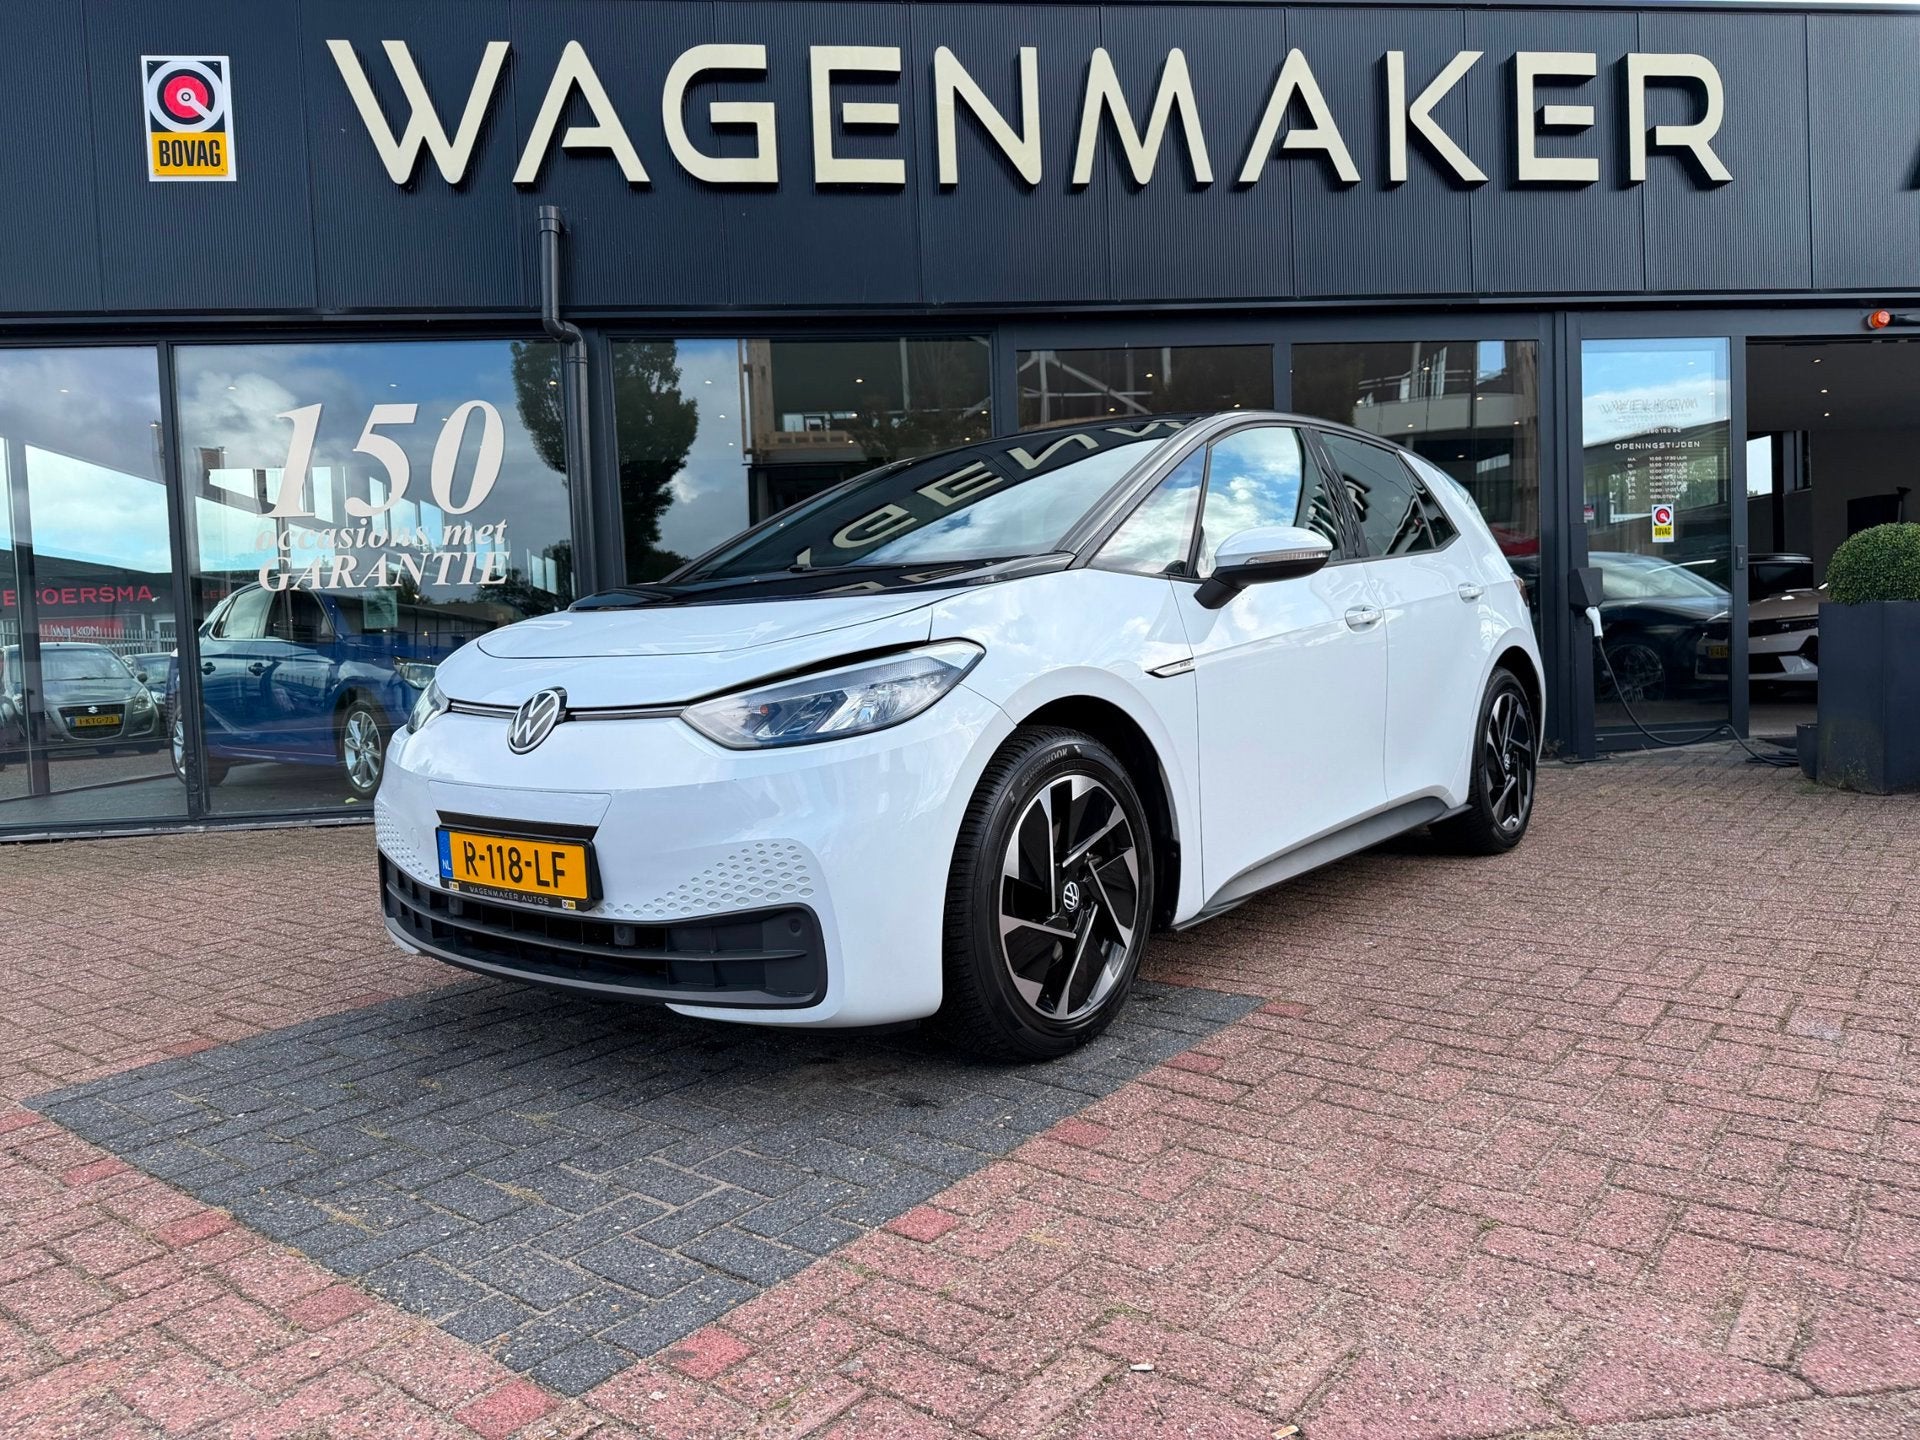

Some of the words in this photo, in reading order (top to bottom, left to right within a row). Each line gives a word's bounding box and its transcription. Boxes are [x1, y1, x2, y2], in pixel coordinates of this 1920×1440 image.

[327, 40, 1733, 187] WAGENMAKER
[158, 139, 221, 167] BOVAG
[256, 399, 506, 518] 150
[1614, 440, 1701, 450] OPENINGSTIJDEN
[254, 517, 431, 551] occasions
[441, 519, 508, 547] met
[1654, 526, 1671, 536] BOVAG
[258, 551, 511, 593] GARANTIE
[442, 859, 452, 871] NL
[463, 840, 566, 889] R-118-LF
[522, 894, 549, 905] AUTOS
